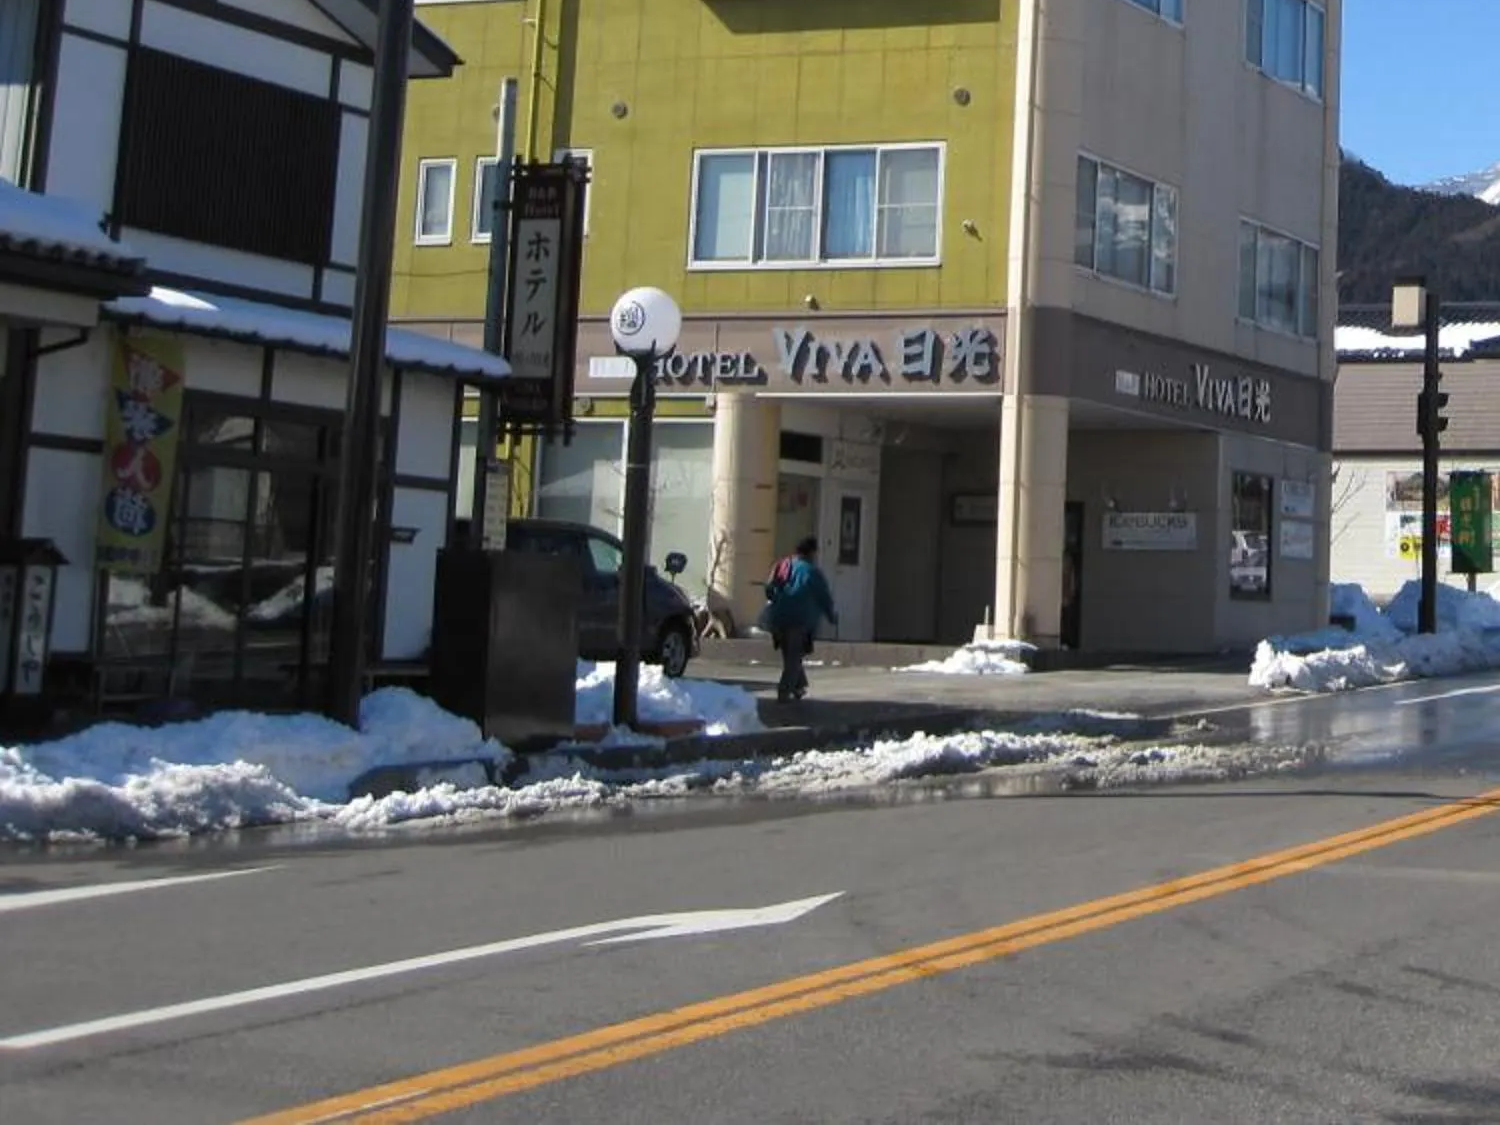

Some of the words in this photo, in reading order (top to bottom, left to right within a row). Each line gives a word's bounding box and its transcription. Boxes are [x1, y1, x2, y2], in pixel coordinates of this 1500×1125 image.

[520, 231, 551, 336] ホテル
[1144, 372, 1190, 405] HOTEL
